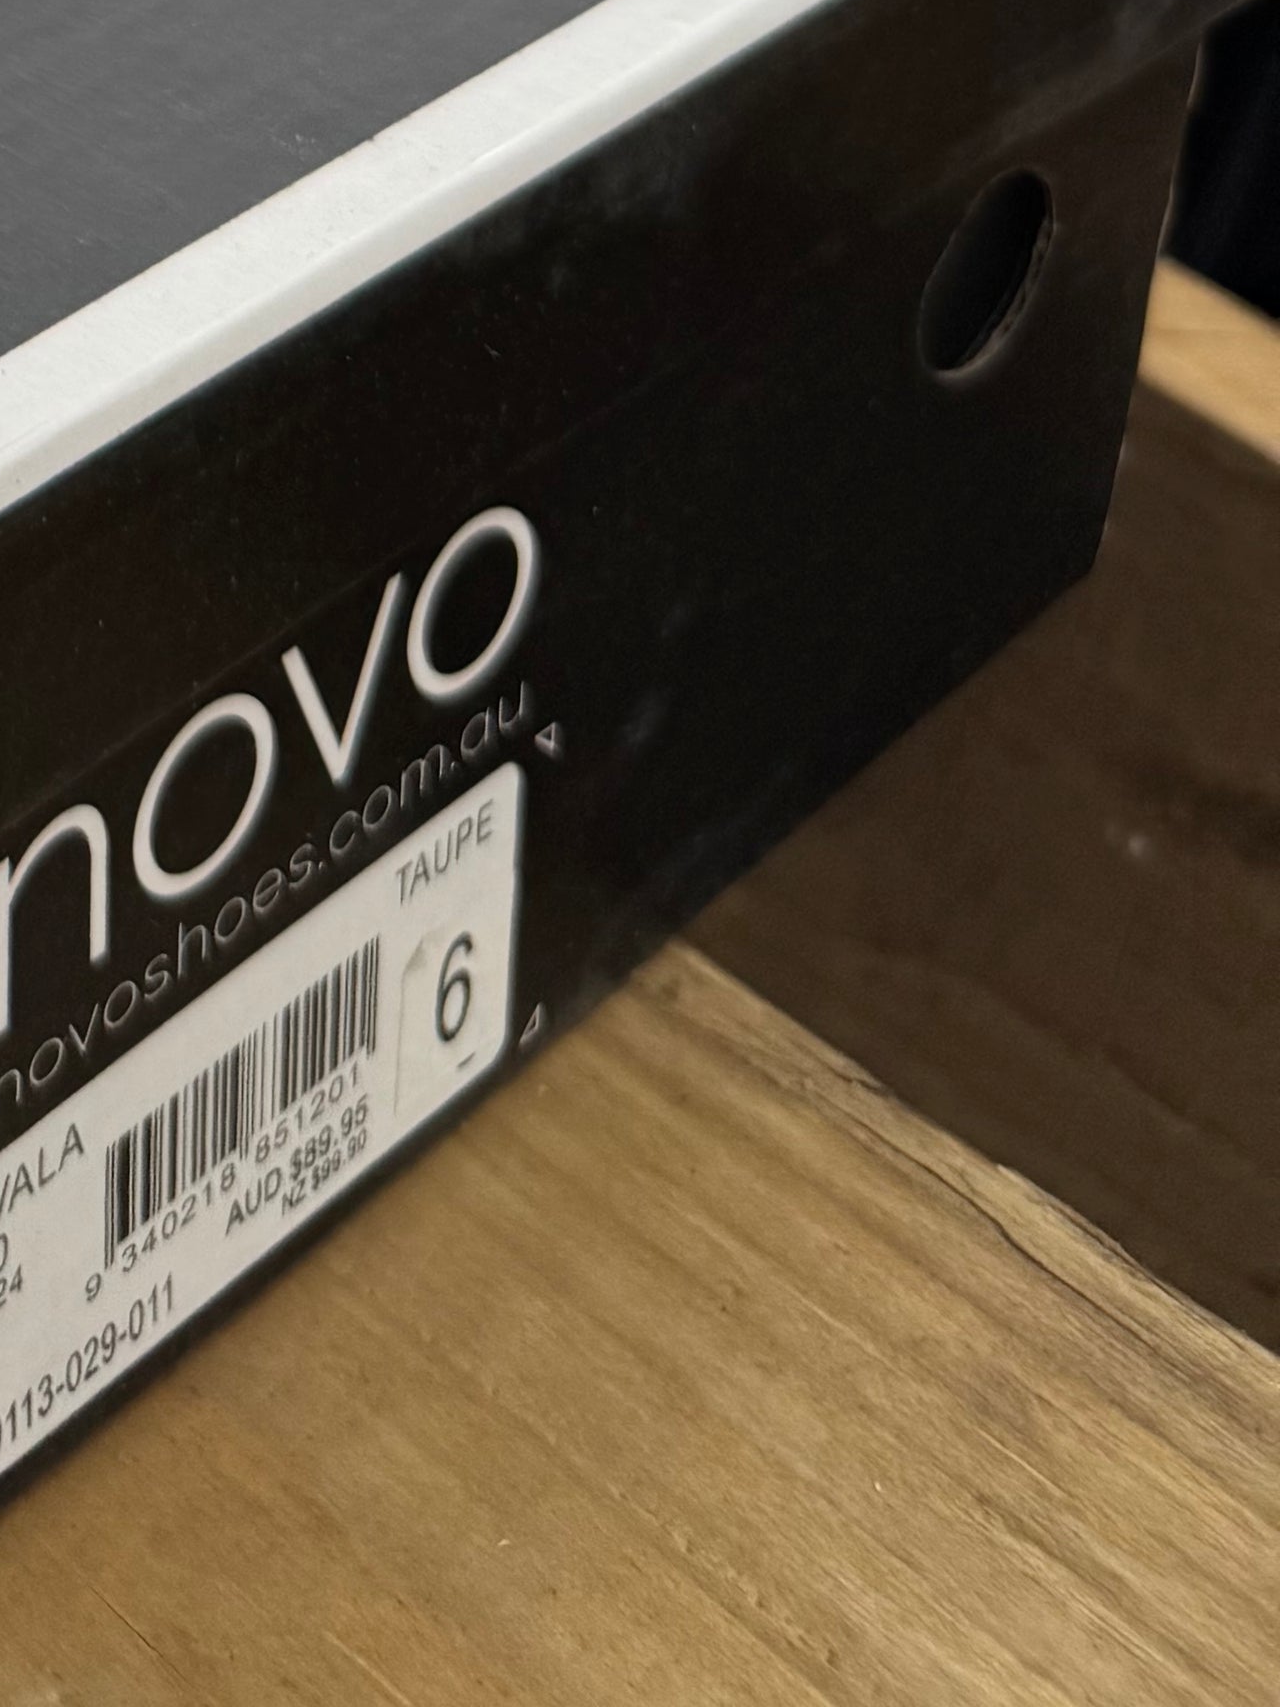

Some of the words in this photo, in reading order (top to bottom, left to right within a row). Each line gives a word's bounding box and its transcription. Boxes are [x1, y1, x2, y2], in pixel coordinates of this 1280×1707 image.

[395, 798, 494, 906] TAUPE
[435, 930, 474, 1043] 6
[121, 1162, 237, 1274] 340218
[254, 1060, 359, 1164] 851201
[223, 1167, 282, 1238] AUD
[290, 1093, 370, 1182] $89.95
